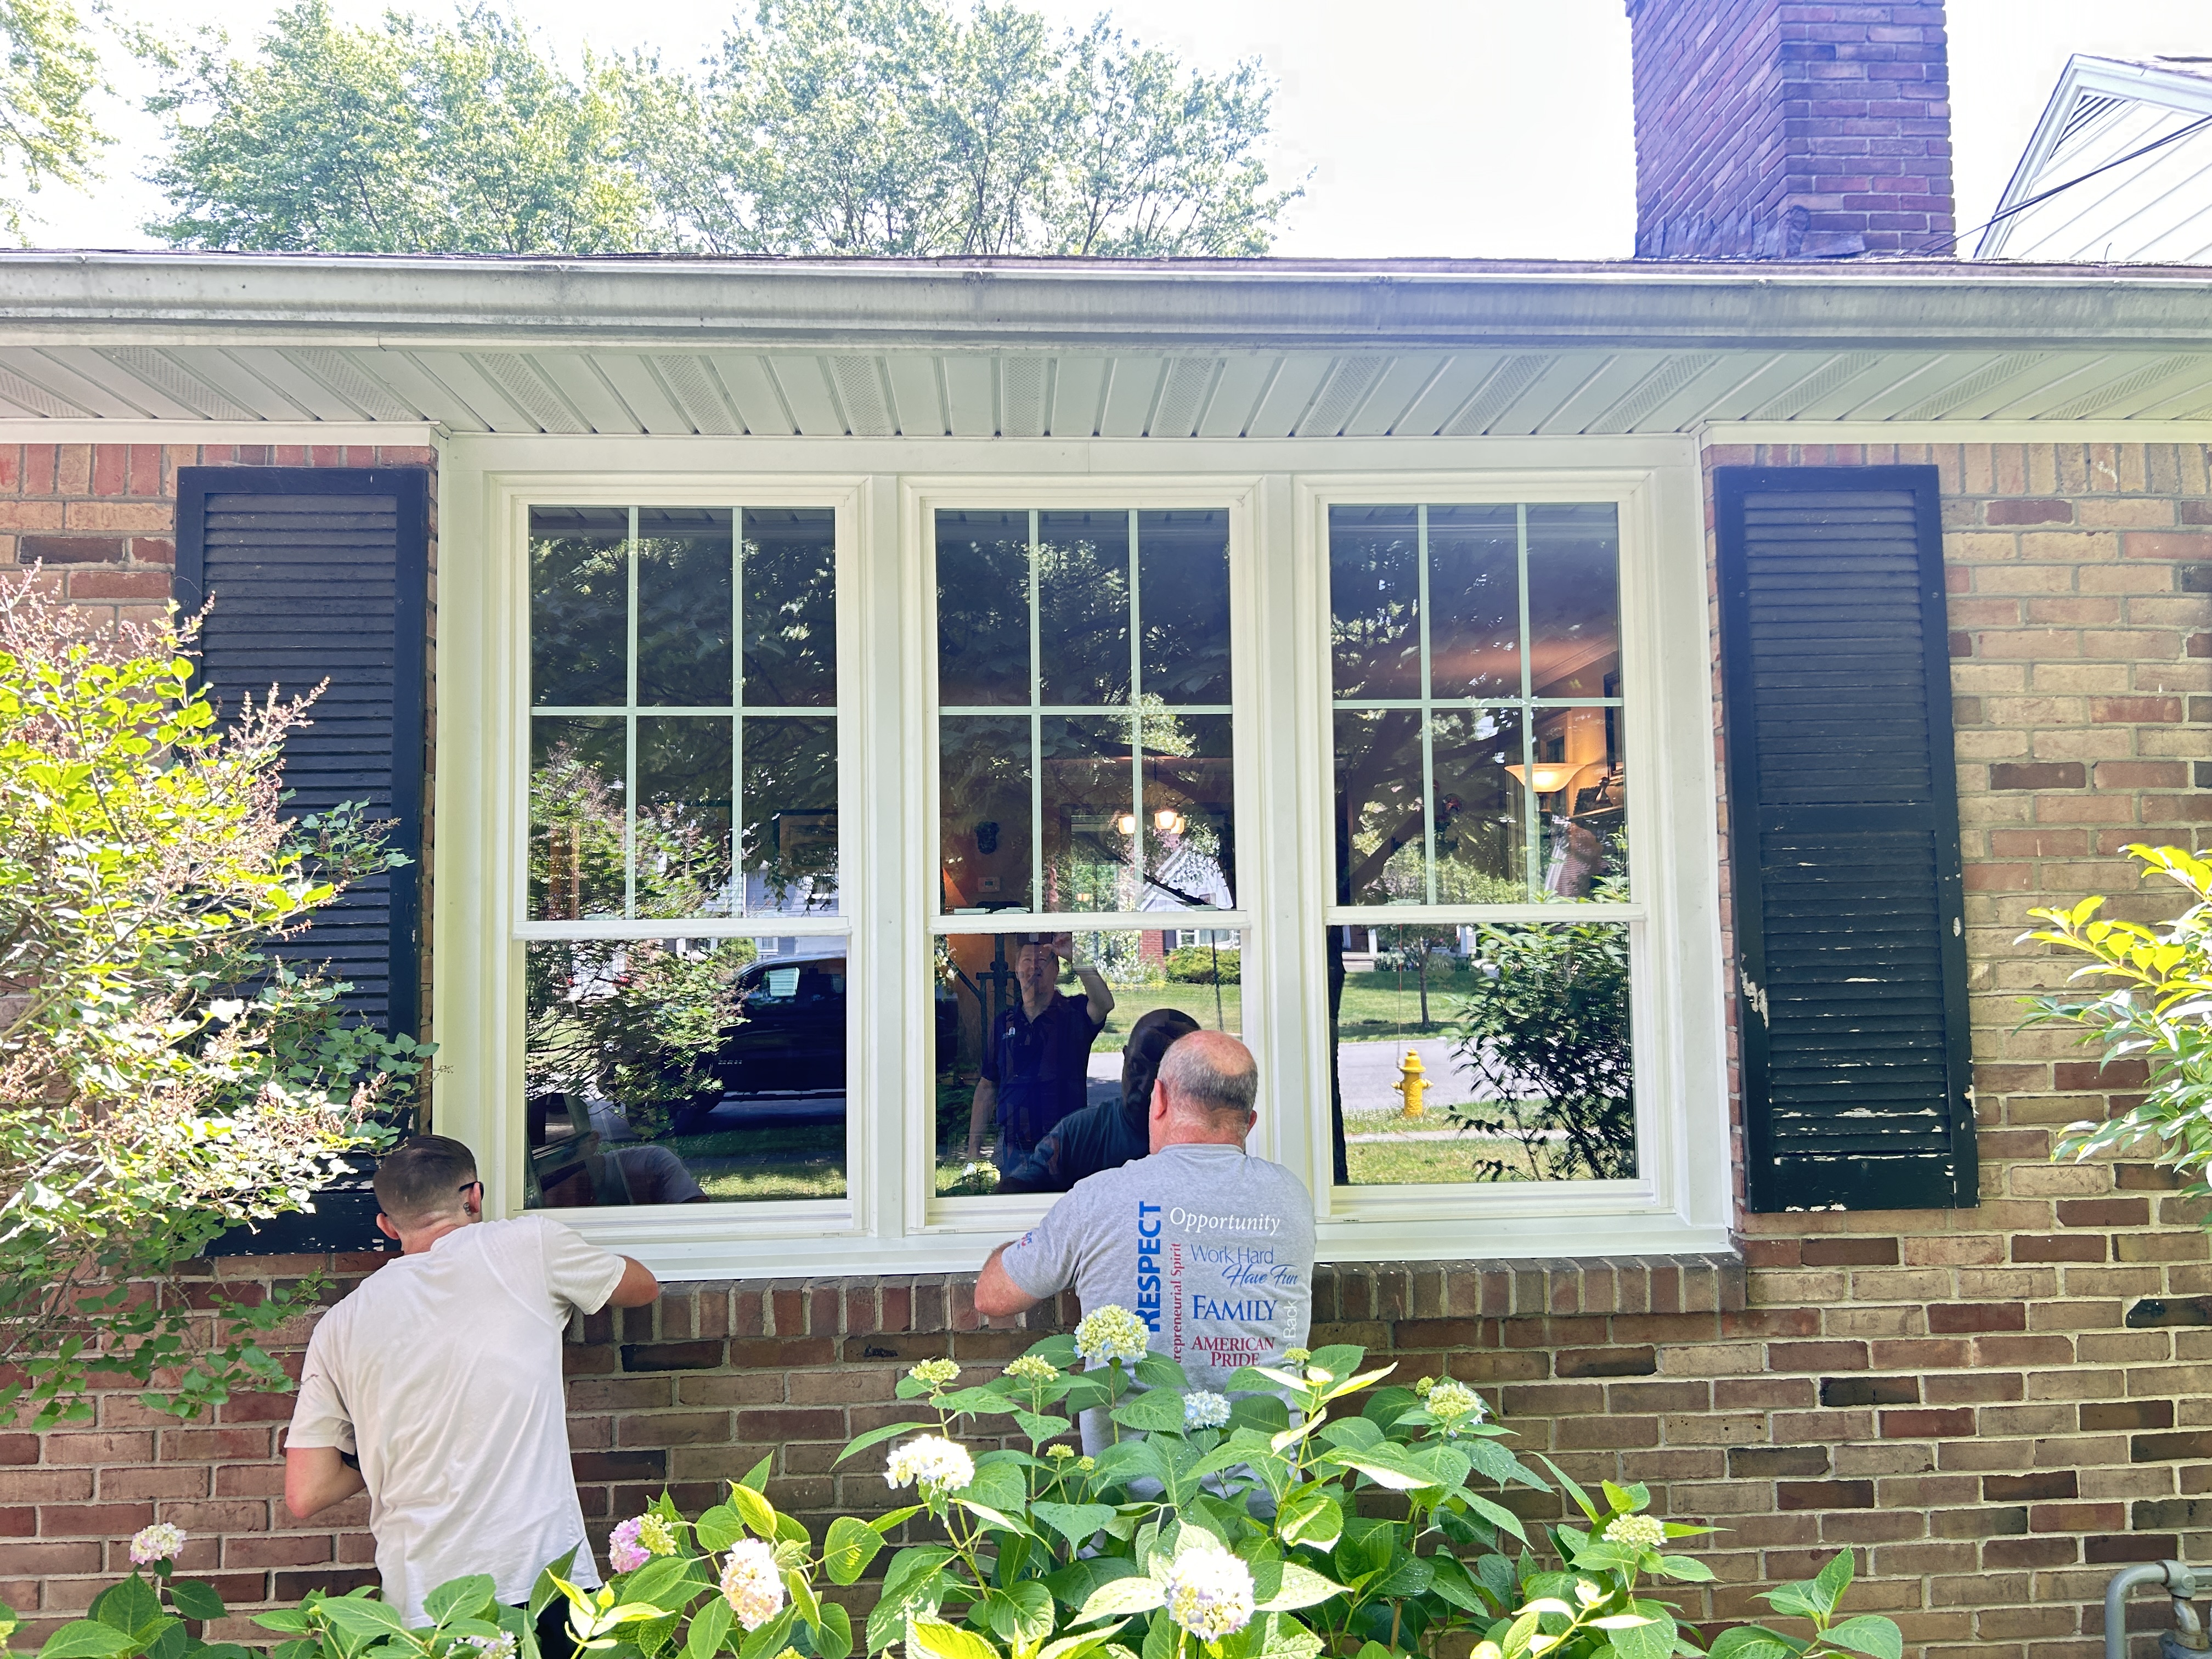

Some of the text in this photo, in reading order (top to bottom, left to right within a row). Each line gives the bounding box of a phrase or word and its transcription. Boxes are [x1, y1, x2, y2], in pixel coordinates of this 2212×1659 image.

[1170, 1207, 1280, 1235] Opportunity
[1134, 1200, 1161, 1331] RESPECT
[1170, 1243, 1184, 1277] Spirit
[1190, 1244, 1273, 1264] Work Hard
[1222, 1263, 1299, 1288] Have Fun
[1191, 1295, 1278, 1321] FAMILY
[1283, 1300, 1297, 1339] Back
[1190, 1335, 1276, 1351] AMERICAN
[1210, 1352, 1260, 1367] PRIDE
